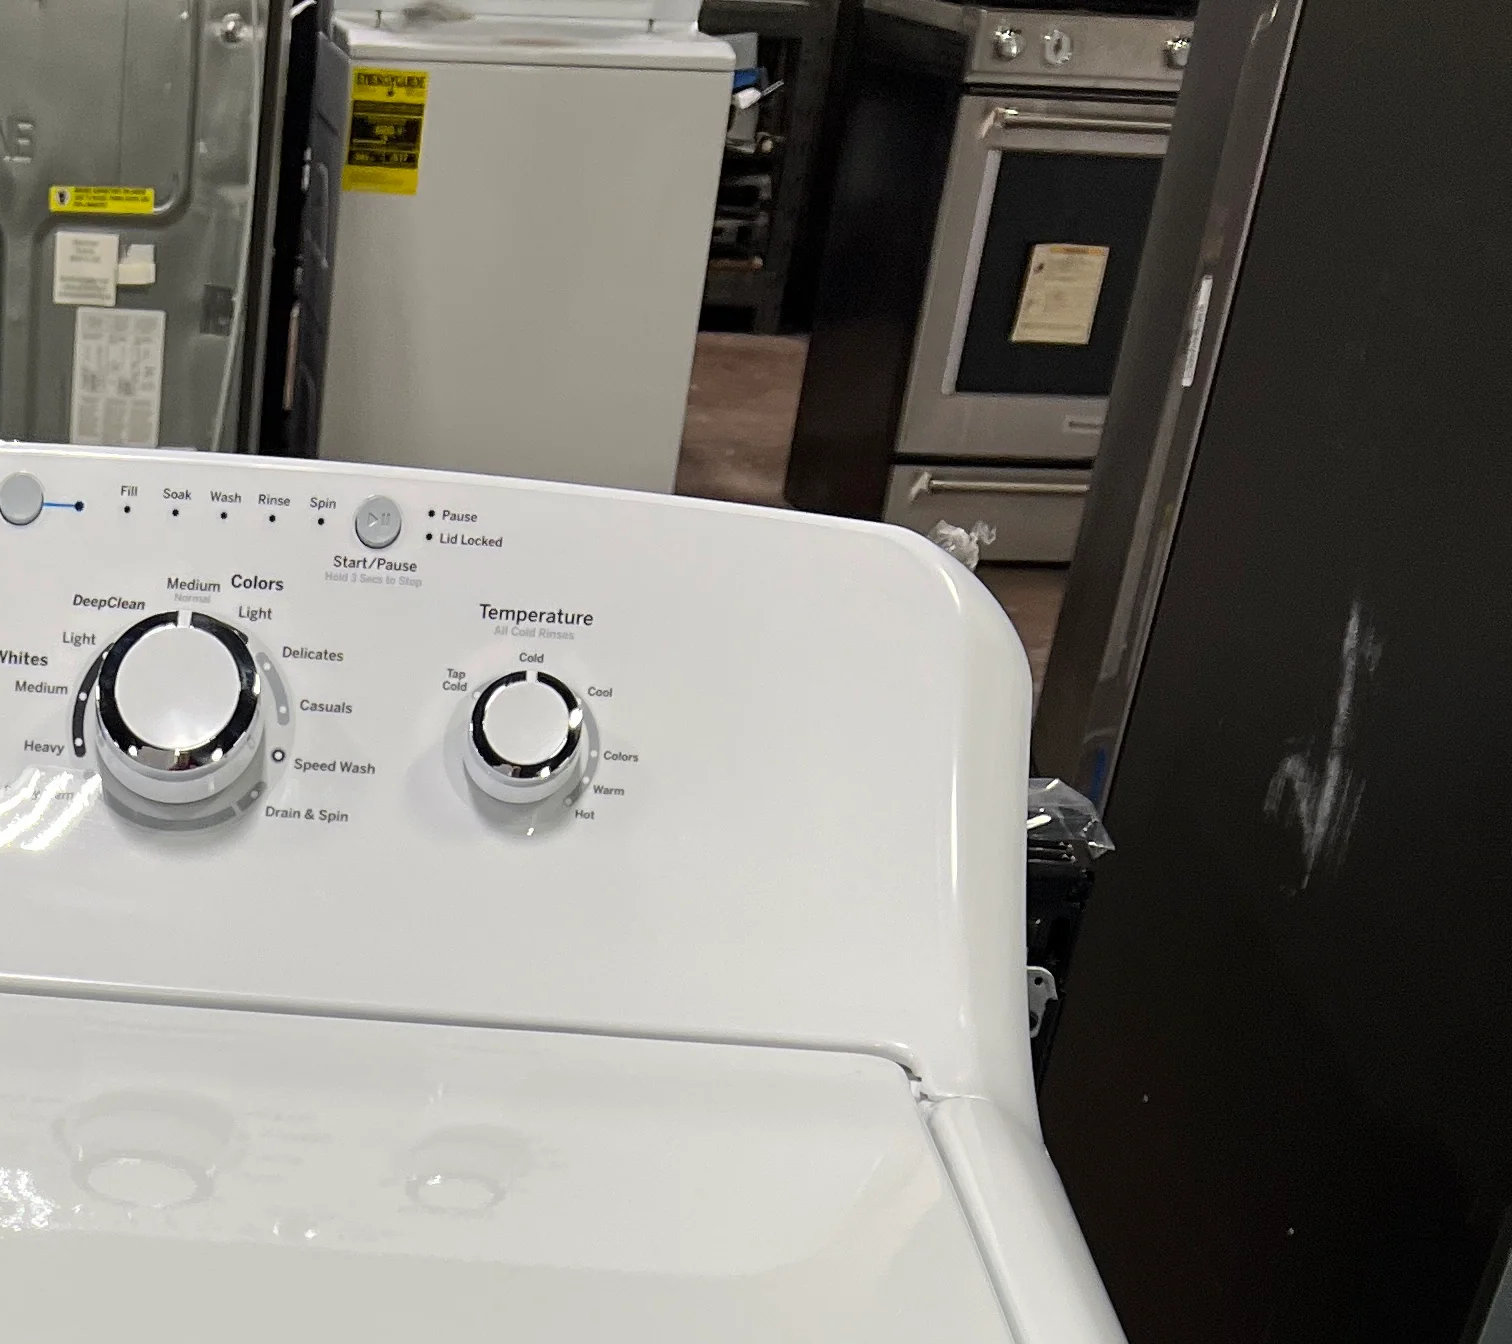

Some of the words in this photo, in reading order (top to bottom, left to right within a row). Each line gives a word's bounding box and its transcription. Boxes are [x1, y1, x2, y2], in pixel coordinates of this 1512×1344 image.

[121, 485, 138, 497] Fill
[163, 488, 192, 500] Soak
[210, 491, 242, 503] Wash
[258, 494, 291, 507] Rinse
[310, 497, 337, 510] Spin
[442, 510, 478, 522] Pause
[440, 533, 458, 544] Lid
[461, 534, 503, 548] Locked
[333, 555, 418, 573] Start/Pause
[167, 577, 221, 593] Medium
[231, 574, 284, 591] Colors
[324, 571, 349, 582] Hold
[359, 573, 383, 584] Secs
[386, 576, 396, 585] to
[398, 576, 422, 588] Stop
[73, 594, 146, 611] DeepClean
[174, 593, 211, 604] Normal
[238, 606, 272, 621] Light
[479, 603, 594, 627] Temperature
[62, 632, 96, 646] Light
[511, 626, 536, 638] Cold
[538, 628, 575, 640] Rinses
[282, 646, 344, 662] Delicates
[519, 652, 545, 664] Cold
[447, 668, 466, 681] Tap
[15, 680, 68, 695] Medium
[442, 681, 468, 692] Cold
[587, 686, 613, 698] Cool
[299, 699, 353, 714] Casuals
[24, 740, 65, 756] Heavy
[603, 751, 639, 763] Colors
[294, 758, 336, 773] Speed
[339, 761, 376, 775] Wash
[593, 785, 625, 796] Warm
[265, 806, 301, 820] Drain
[304, 809, 315, 821] &
[319, 809, 349, 823] Spin
[575, 809, 595, 820] Hot
